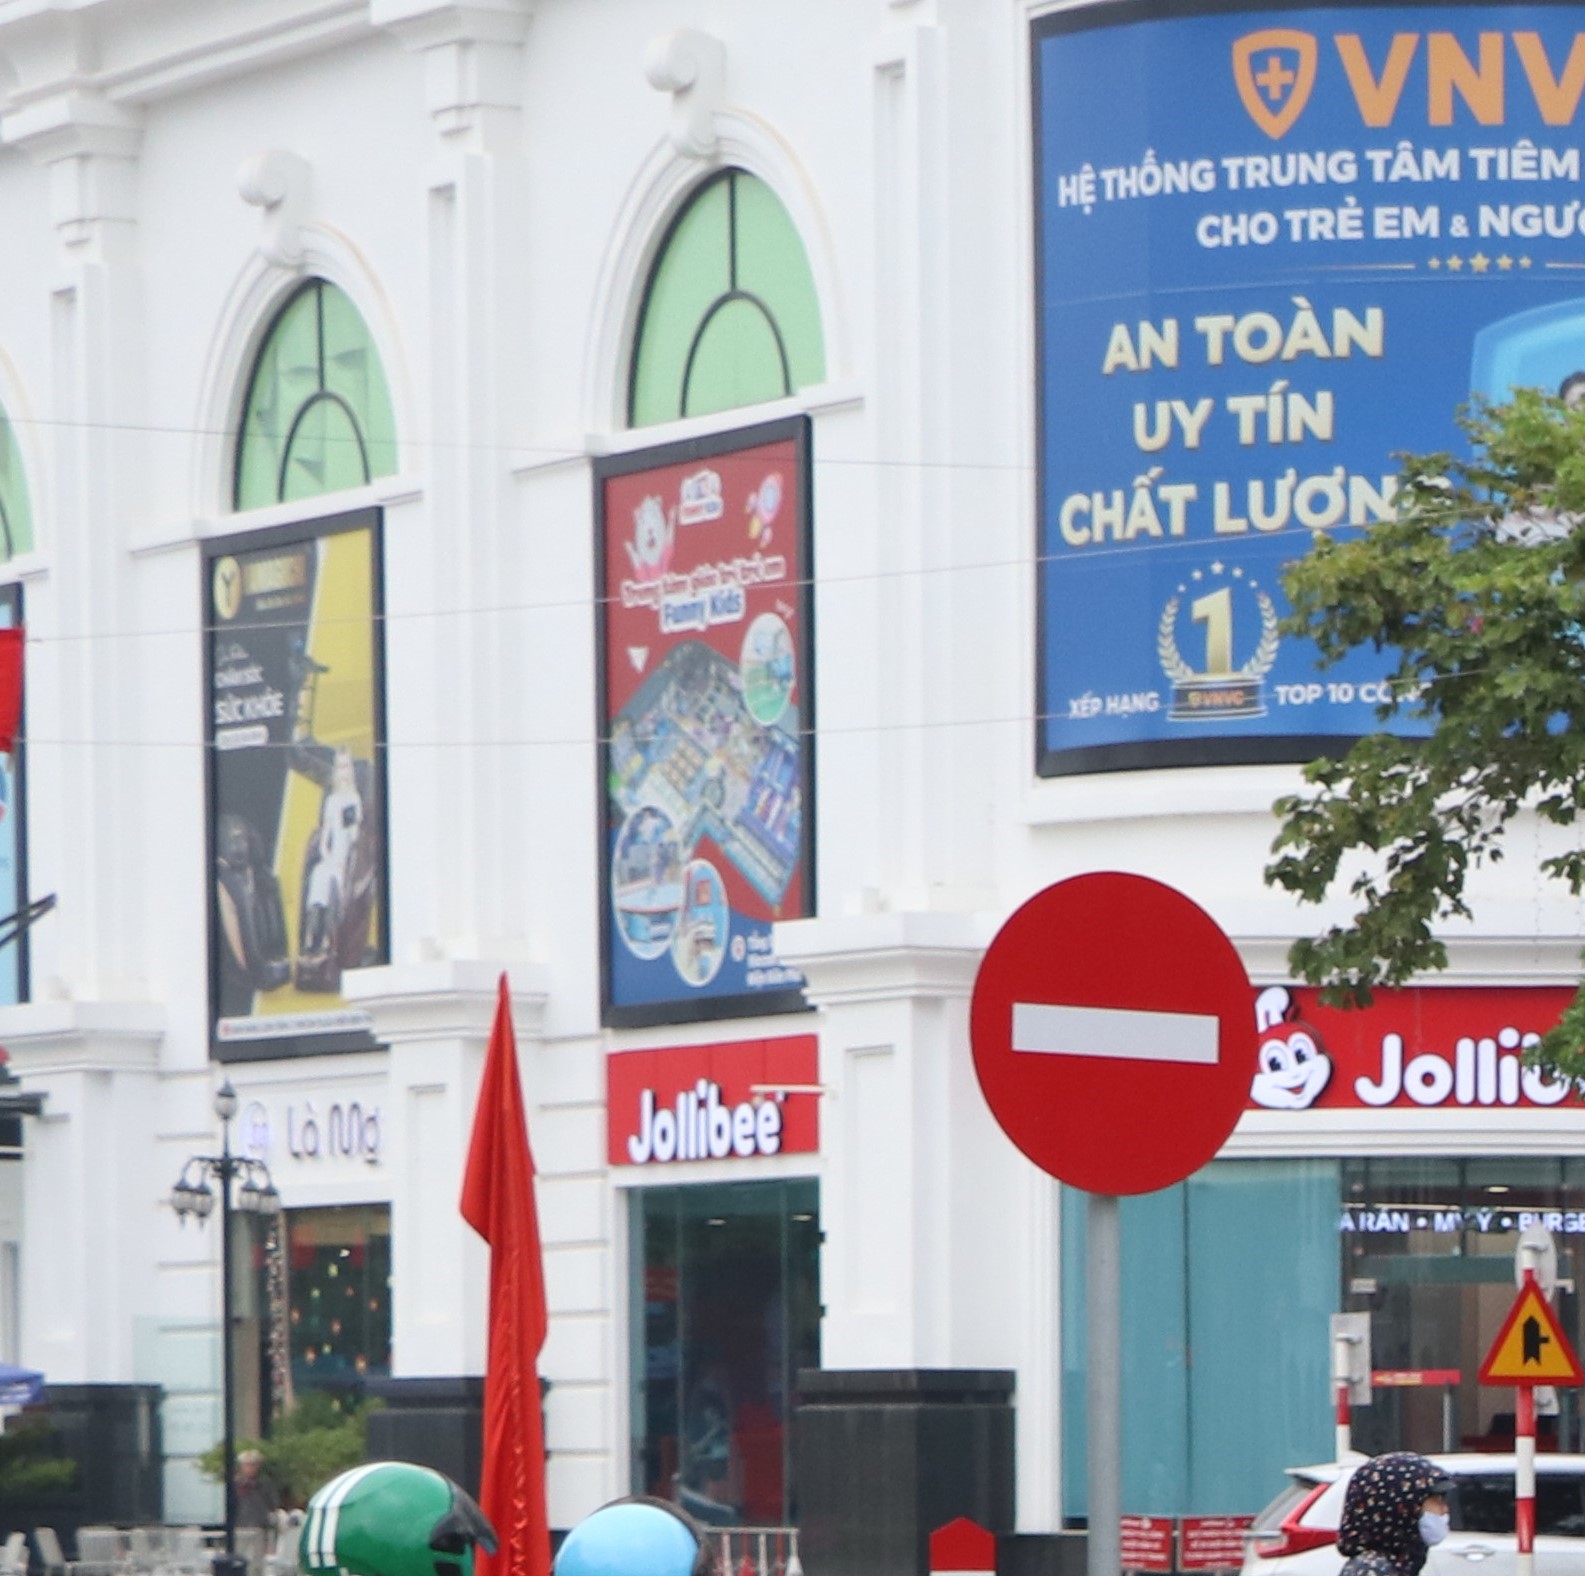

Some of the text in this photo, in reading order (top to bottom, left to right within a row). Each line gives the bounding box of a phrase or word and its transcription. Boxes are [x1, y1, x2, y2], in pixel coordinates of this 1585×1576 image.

[1058, 164, 1096, 215] HỆ
[1100, 148, 1215, 197] THỐNG
[1225, 150, 1357, 192] TRUNG
[1366, 142, 1460, 184] TÂM
[1470, 139, 1580, 184] TIÊM
[1197, 209, 1279, 249] CHO
[1285, 195, 1365, 241] TRẺ
[1373, 205, 1440, 239] EM
[1449, 212, 1471, 239] &
[1103, 297, 1385, 375] AN TOÀN
[1133, 380, 1334, 453] UY TÍN
[1059, 466, 1198, 547] CHẤT
[1069, 689, 1101, 719] XẾP
[1106, 691, 1161, 719] HẠNG
[1274, 684, 1322, 706] TOP
[1327, 682, 1353, 704] 10
[628, 1078, 782, 1165] Jollibee
